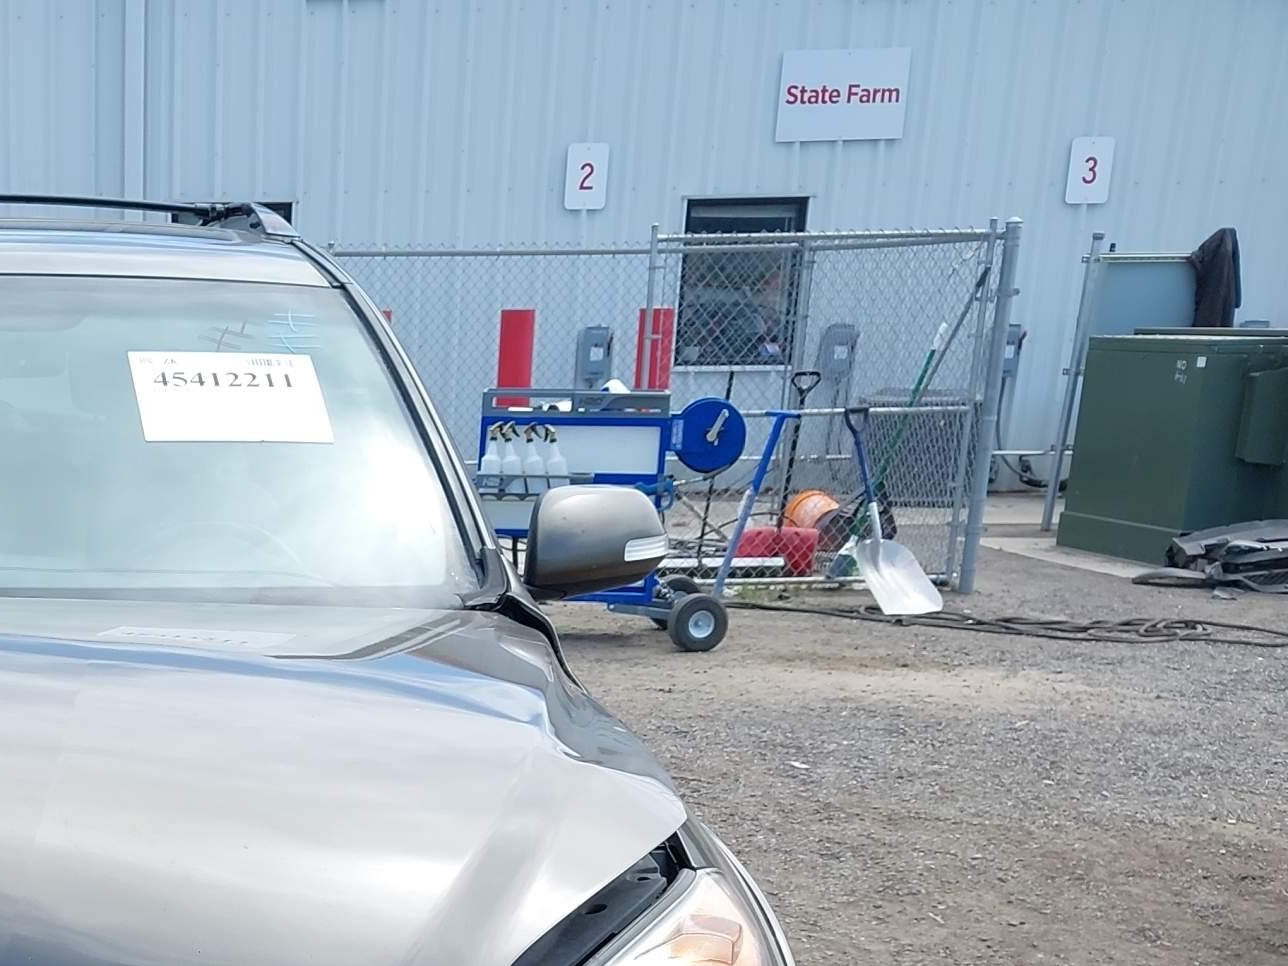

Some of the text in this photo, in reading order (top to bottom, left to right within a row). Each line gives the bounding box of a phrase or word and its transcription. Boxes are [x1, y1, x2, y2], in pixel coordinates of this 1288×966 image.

[785, 84, 900, 104] State Farm
[579, 162, 595, 190] 2
[1082, 156, 1098, 185] 3
[153, 371, 296, 388] 45412211
